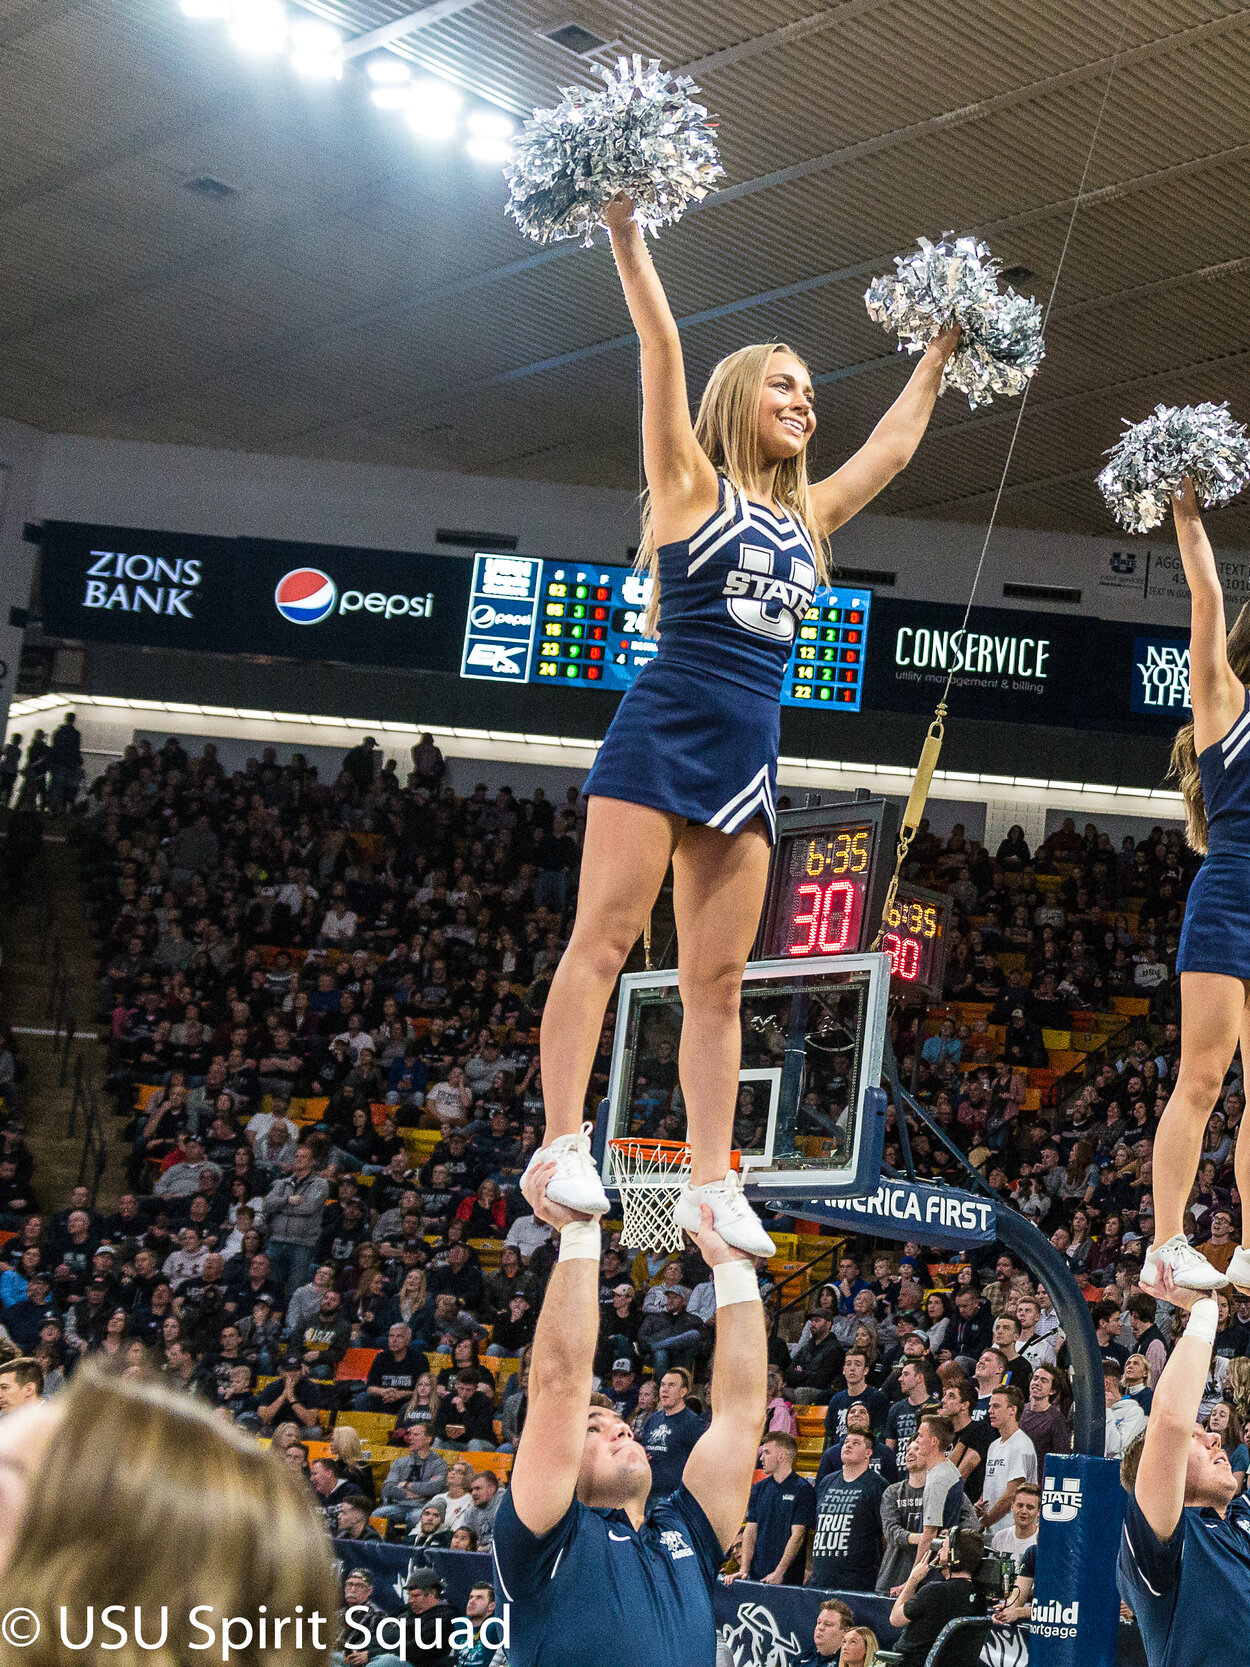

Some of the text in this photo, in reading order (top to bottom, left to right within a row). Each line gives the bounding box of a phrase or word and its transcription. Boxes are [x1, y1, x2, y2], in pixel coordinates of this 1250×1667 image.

[86, 550, 202, 586] ZIONS
[83, 581, 194, 618] BANK
[339, 589, 434, 619] pepsi
[722, 570, 814, 622] STATE
[828, 609, 838, 622] 4
[571, 625, 582, 639] 4
[826, 629, 836, 642] 2
[800, 647, 816, 659] 12
[824, 648, 834, 661] 2
[895, 628, 1050, 678] CONSERVICE
[1146, 646, 1191, 668] NEW
[539, 662, 557, 676] 24
[798, 666, 813, 679] 14
[822, 668, 832, 681] 2
[1136, 663, 1190, 689] YOR
[795, 686, 812, 699] 22
[895, 671, 922, 683] utility
[925, 674, 999, 689] management
[1013, 681, 1044, 695] billing
[1144, 683, 1193, 709] LIFE
[807, 832, 869, 876] 6:35
[789, 881, 854, 955] 30
[888, 901, 937, 938] 6:35
[883, 932, 919, 979] 30
[926, 1196, 992, 1231] FIRST
[1042, 1490, 1082, 1508] STATE
[817, 1514, 854, 1531] TRUE
[813, 1532, 850, 1550] BLUE
[1031, 1598, 1079, 1624] Guild
